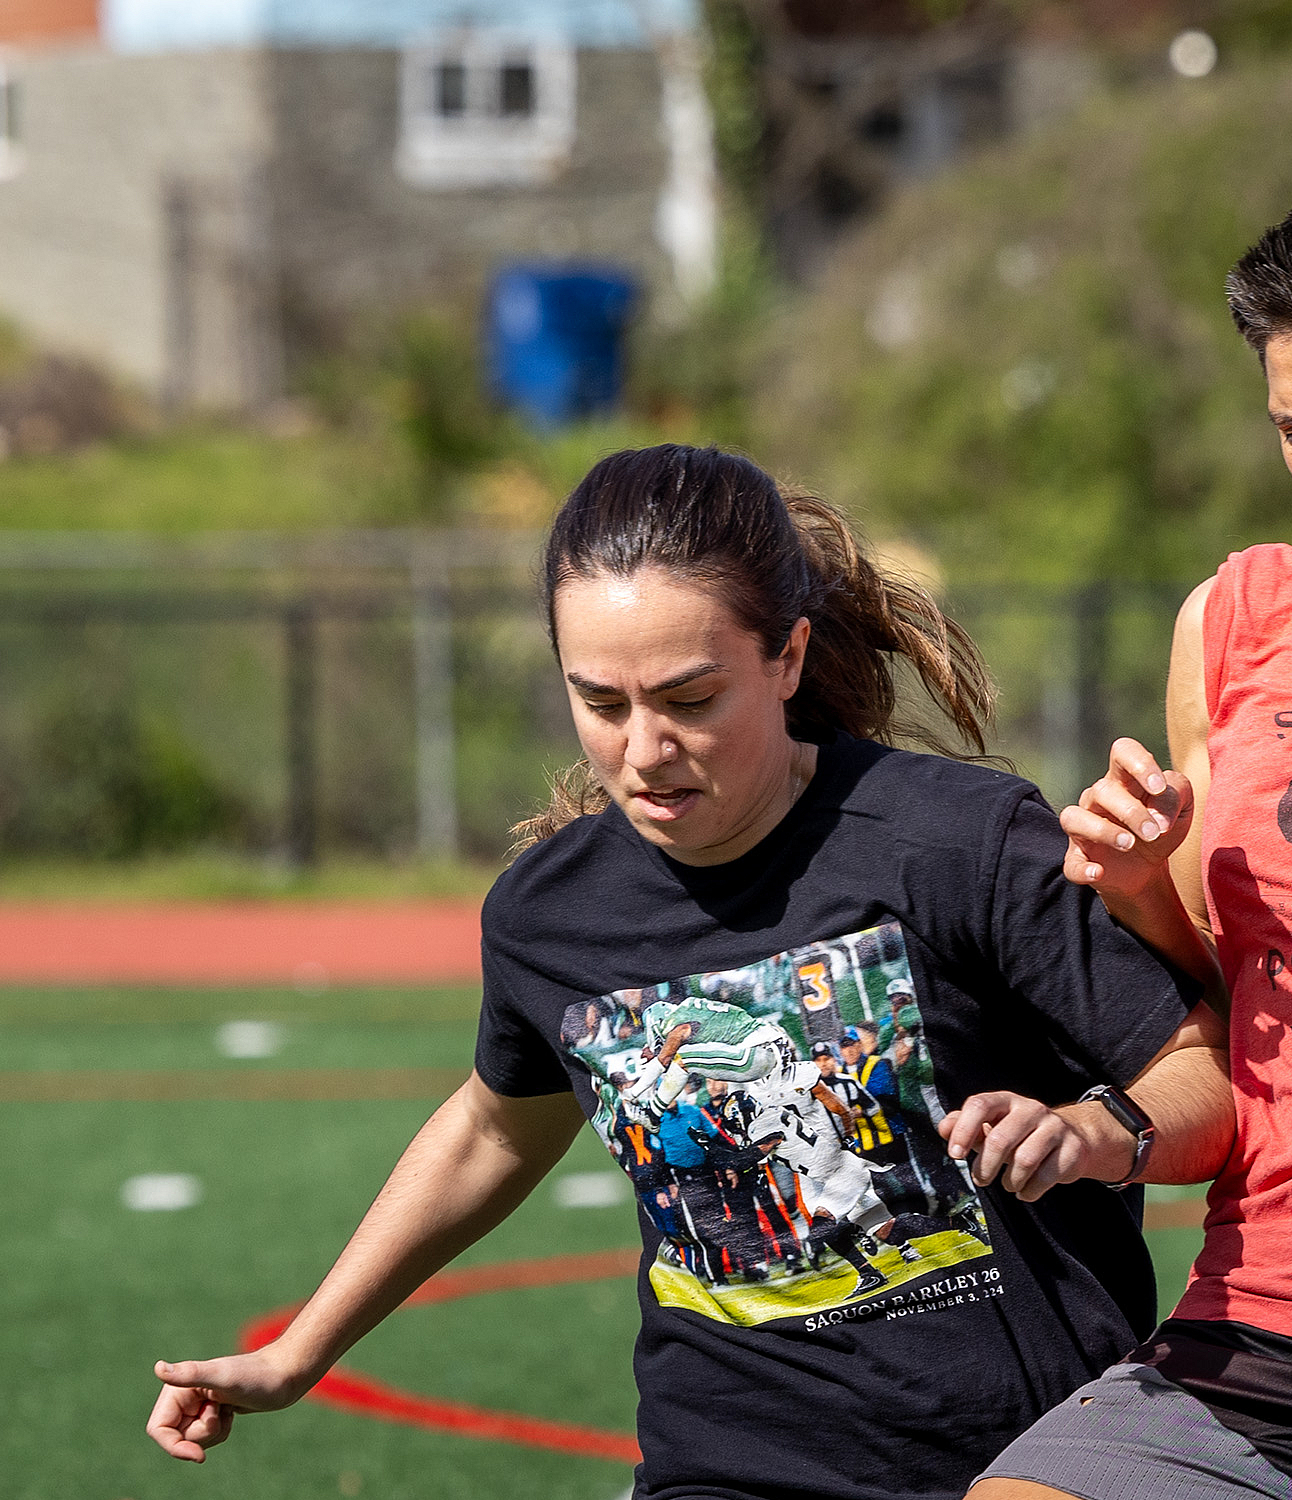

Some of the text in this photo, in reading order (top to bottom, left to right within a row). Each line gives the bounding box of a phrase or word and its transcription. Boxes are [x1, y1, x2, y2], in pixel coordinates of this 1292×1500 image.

[798, 961, 832, 1012] 3
[804, 1266, 1001, 1333] SAQUON BARKLEY 26
[885, 1293, 965, 1321] NOVEMBER
